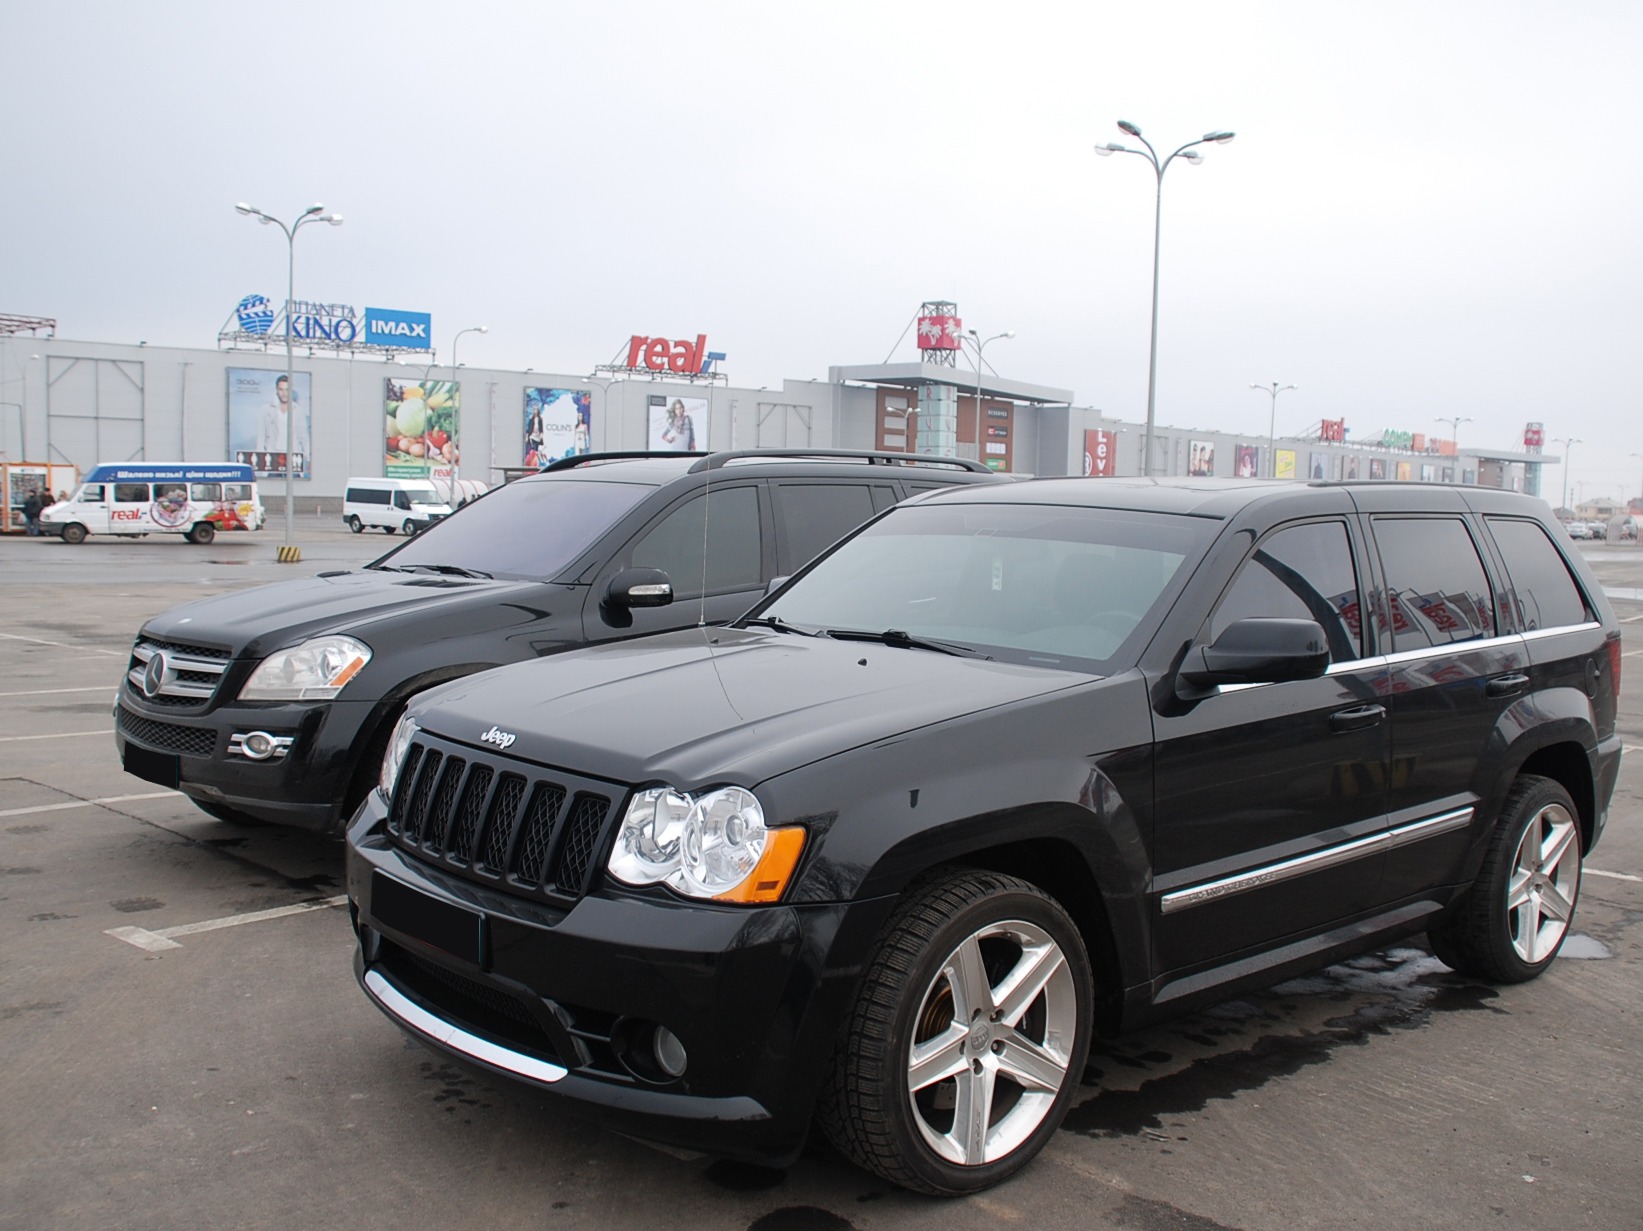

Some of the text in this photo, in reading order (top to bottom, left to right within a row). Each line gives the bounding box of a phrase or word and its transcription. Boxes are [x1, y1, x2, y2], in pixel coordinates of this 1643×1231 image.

[285, 314, 356, 343] KINO
[371, 319, 426, 338] IMAX
[545, 423, 572, 432] COLIN'S
[1097, 428, 1107, 476] Lev
[481, 726, 516, 749] Jeep
